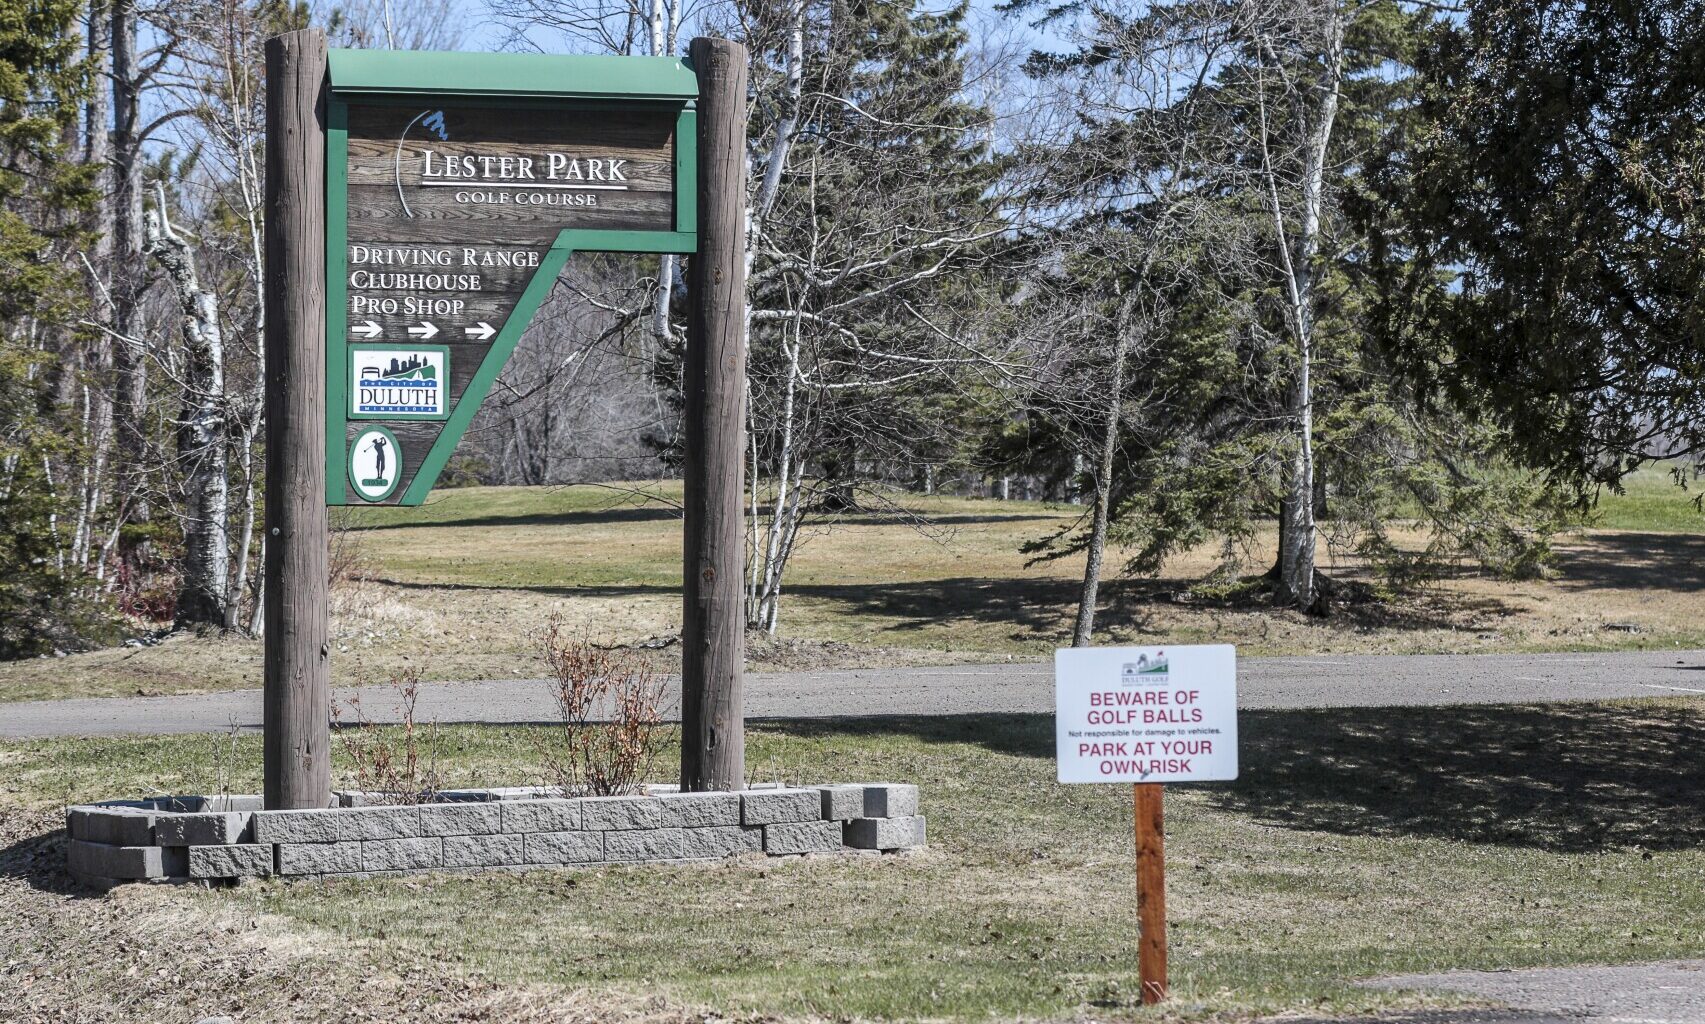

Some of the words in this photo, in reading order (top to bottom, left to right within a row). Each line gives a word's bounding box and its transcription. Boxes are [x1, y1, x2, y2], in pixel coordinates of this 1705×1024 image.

[422, 150, 535, 179] LESTER
[546, 153, 627, 181] PARK
[455, 191, 510, 204] GOLF
[515, 192, 597, 206] COURSE
[351, 246, 451, 266] DRIVING
[462, 248, 540, 267] RANGE
[350, 270, 482, 291] CLUBHOUSE
[351, 295, 398, 314] PRO
[403, 296, 465, 315] SHOP
[360, 388, 437, 405] DULUTH
[1090, 691, 1169, 707] BEWARE
[1175, 690, 1200, 705] OF
[1087, 710, 1137, 725] GOLF
[1143, 708, 1203, 724] BALLS
[1084, 730, 1129, 738] responsible
[1145, 729, 1175, 738] damage
[1079, 742, 1128, 757] PARK
[1133, 741, 1155, 756] AT
[1161, 740, 1212, 755] YOUR
[1100, 760, 1144, 775] OWN
[1150, 759, 1192, 774] RISK
